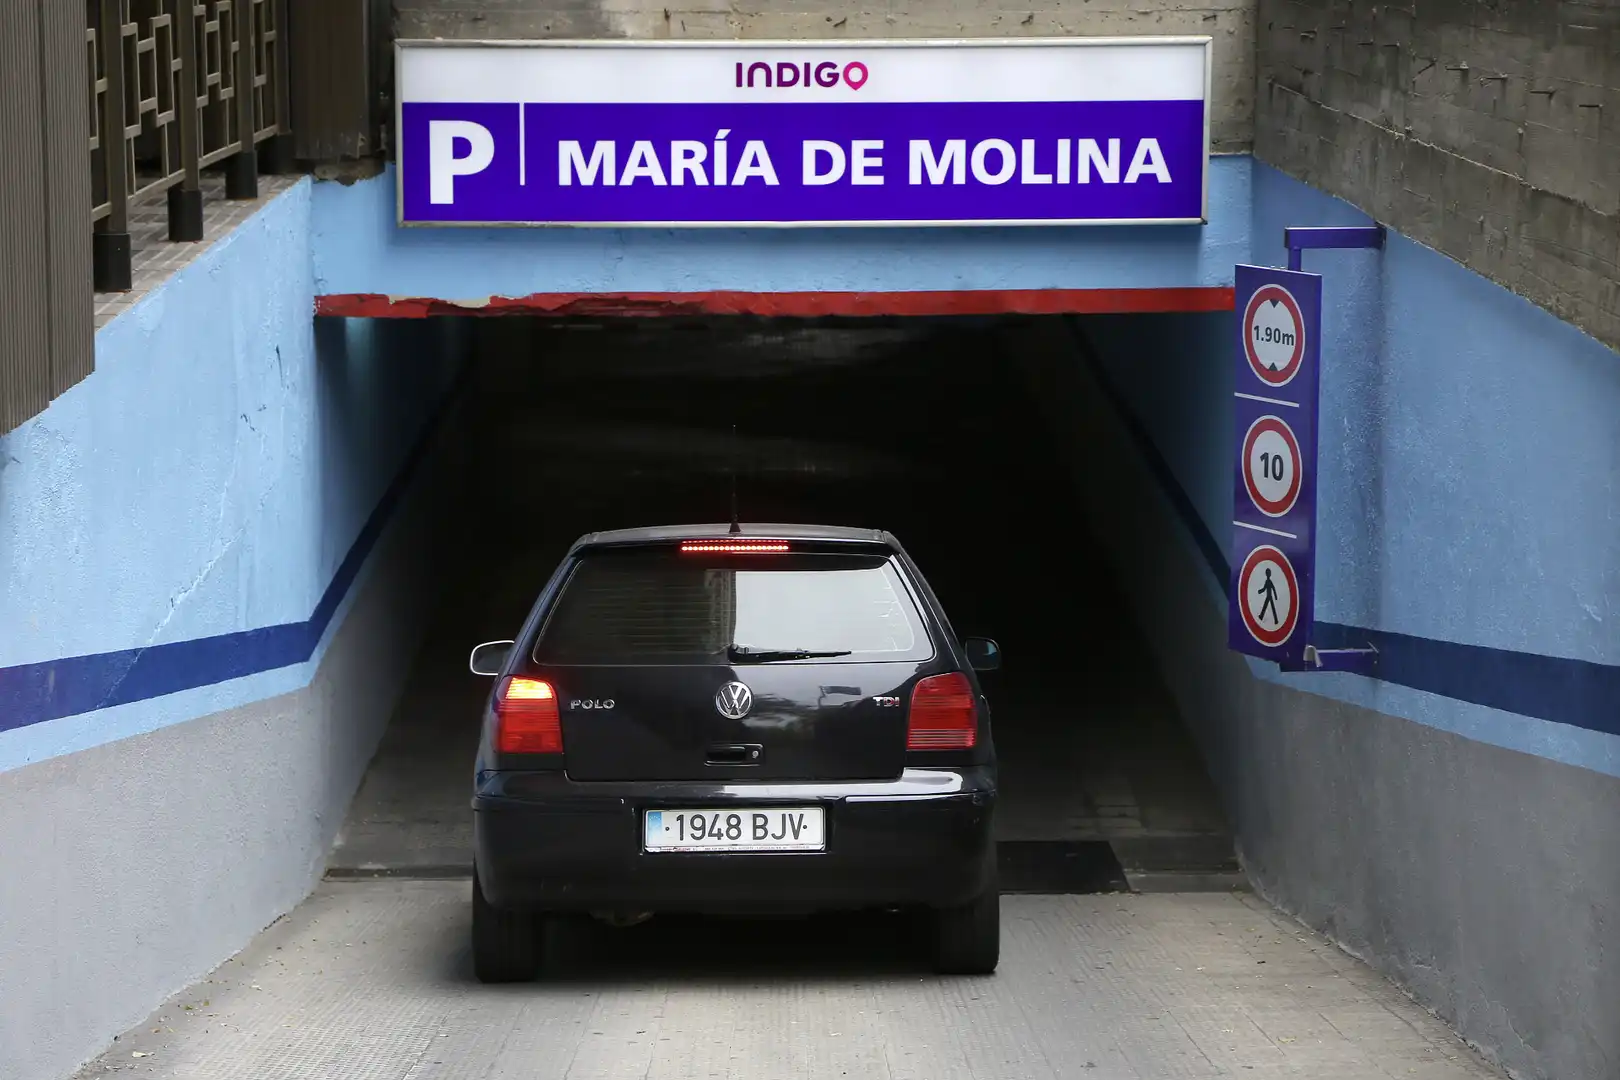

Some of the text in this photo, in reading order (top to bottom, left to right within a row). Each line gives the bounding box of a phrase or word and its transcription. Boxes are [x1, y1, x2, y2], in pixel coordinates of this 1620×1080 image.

[735, 61, 869, 91] INDIGO
[429, 120, 495, 205] P
[557, 128, 1173, 187] MARÍA DE MOLINA
[1253, 325, 1295, 346] 1.90m
[1259, 451, 1284, 482] 10
[570, 698, 616, 710] POLO
[872, 696, 901, 708] TDI
[675, 813, 805, 842] 1948 BJV
